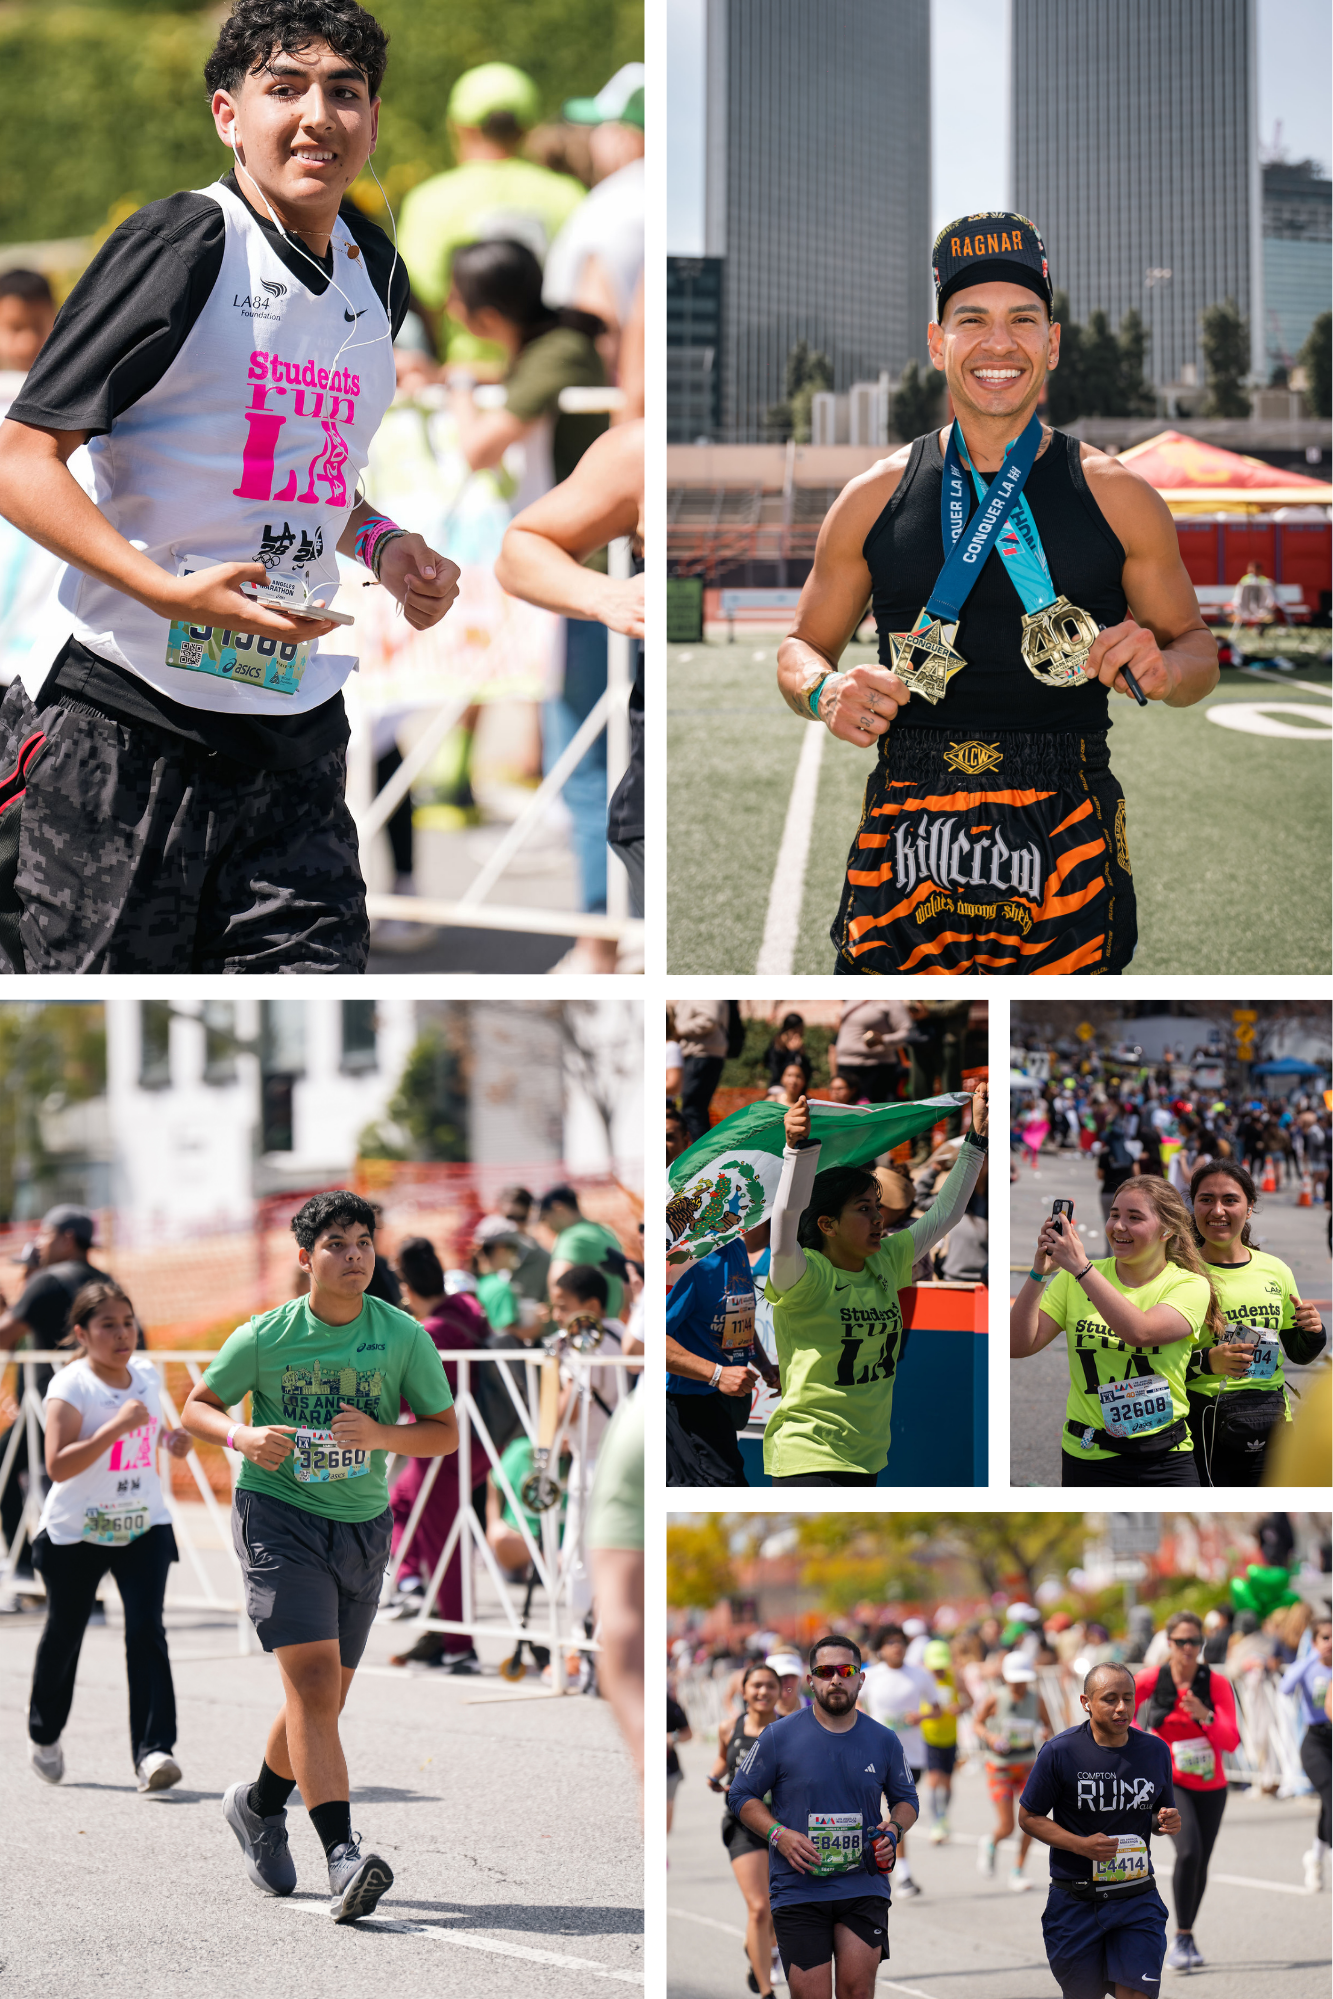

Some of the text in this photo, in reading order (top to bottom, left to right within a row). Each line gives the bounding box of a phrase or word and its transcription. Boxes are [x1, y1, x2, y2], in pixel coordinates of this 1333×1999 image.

[951, 230, 1023, 257] RAGNAR
[233, 294, 270, 310] LA84
[241, 309, 281, 321] Foundation
[248, 350, 360, 397] Students
[245, 383, 355, 426] run
[233, 412, 347, 507] LA
[950, 480, 963, 543] QUER LA
[962, 498, 1005, 563] CONQUER
[997, 481, 1015, 498] LA
[906, 634, 950, 657] CONQUER
[1023, 606, 1095, 667] 40
[235, 664, 261, 679] asics
[957, 748, 989, 766] KLCW
[915, 893, 954, 925] wolves
[1226, 1303, 1280, 1320] udents
[282, 1394, 381, 1411] LOS ANGELES
[1110, 1397, 1166, 1423] 32608
[300, 1449, 366, 1469] 32660
[90, 1514, 144, 1532] 32600
[1077, 1771, 1117, 1780] COMPTON
[1077, 1779, 1140, 1811] RUN
[811, 1835, 860, 1849] E8488
[1097, 1856, 1145, 1874] C4414
